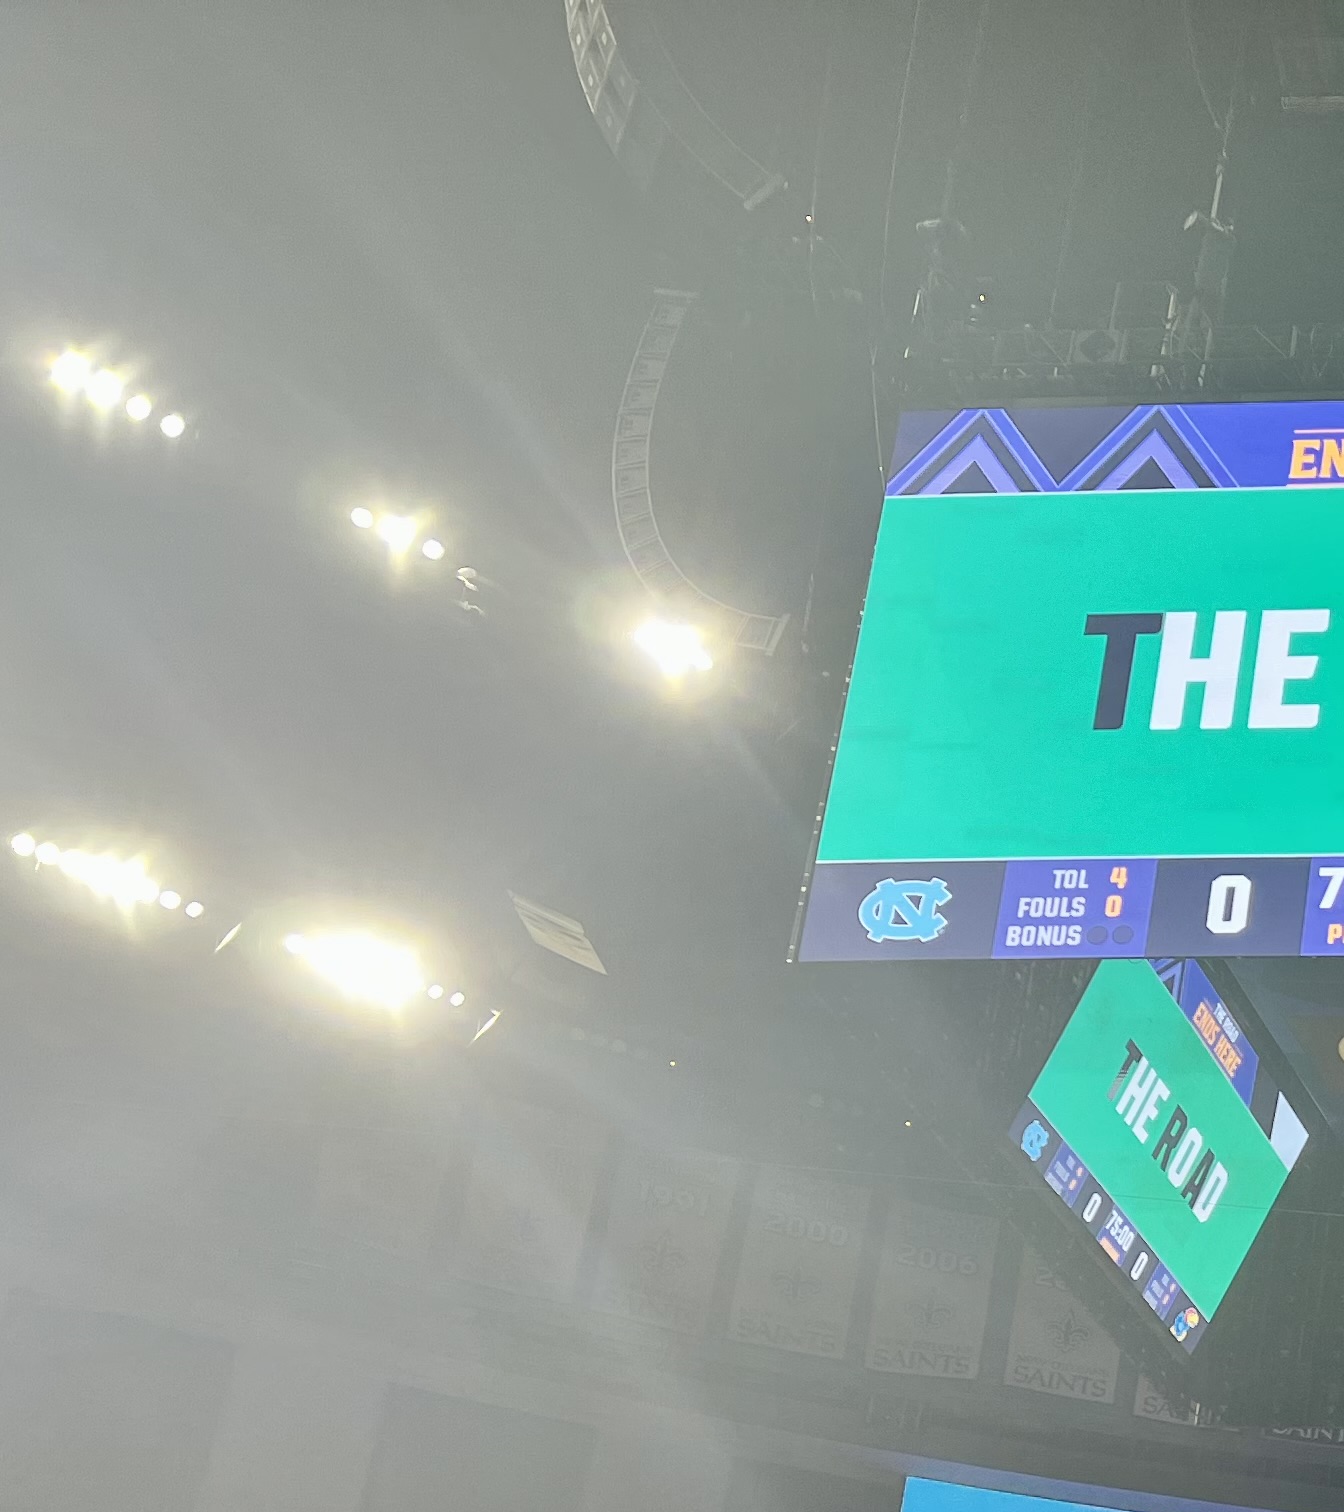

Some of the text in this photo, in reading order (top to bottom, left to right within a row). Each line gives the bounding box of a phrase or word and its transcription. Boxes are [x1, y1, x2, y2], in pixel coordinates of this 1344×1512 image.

[1083, 608, 1330, 730] THE
[1052, 867, 1128, 890] TOL 4
[1017, 896, 1122, 919] FOULS 0
[1206, 873, 1252, 936] 0
[1005, 924, 1082, 947] BONUS
[1192, 1001, 1243, 1078] ENDS HERE
[1107, 1038, 1172, 1144] THE
[1152, 1104, 1229, 1223] ROAD
[1082, 1192, 1102, 1223] 0
[764, 1212, 849, 1247] 2000
[1105, 1209, 1135, 1252] 75:00
[896, 1243, 978, 1276] 2006
[1130, 1252, 1148, 1281] 0
[873, 1348, 971, 1375] SAINTS
[1013, 1364, 1107, 1399] SAINTS
